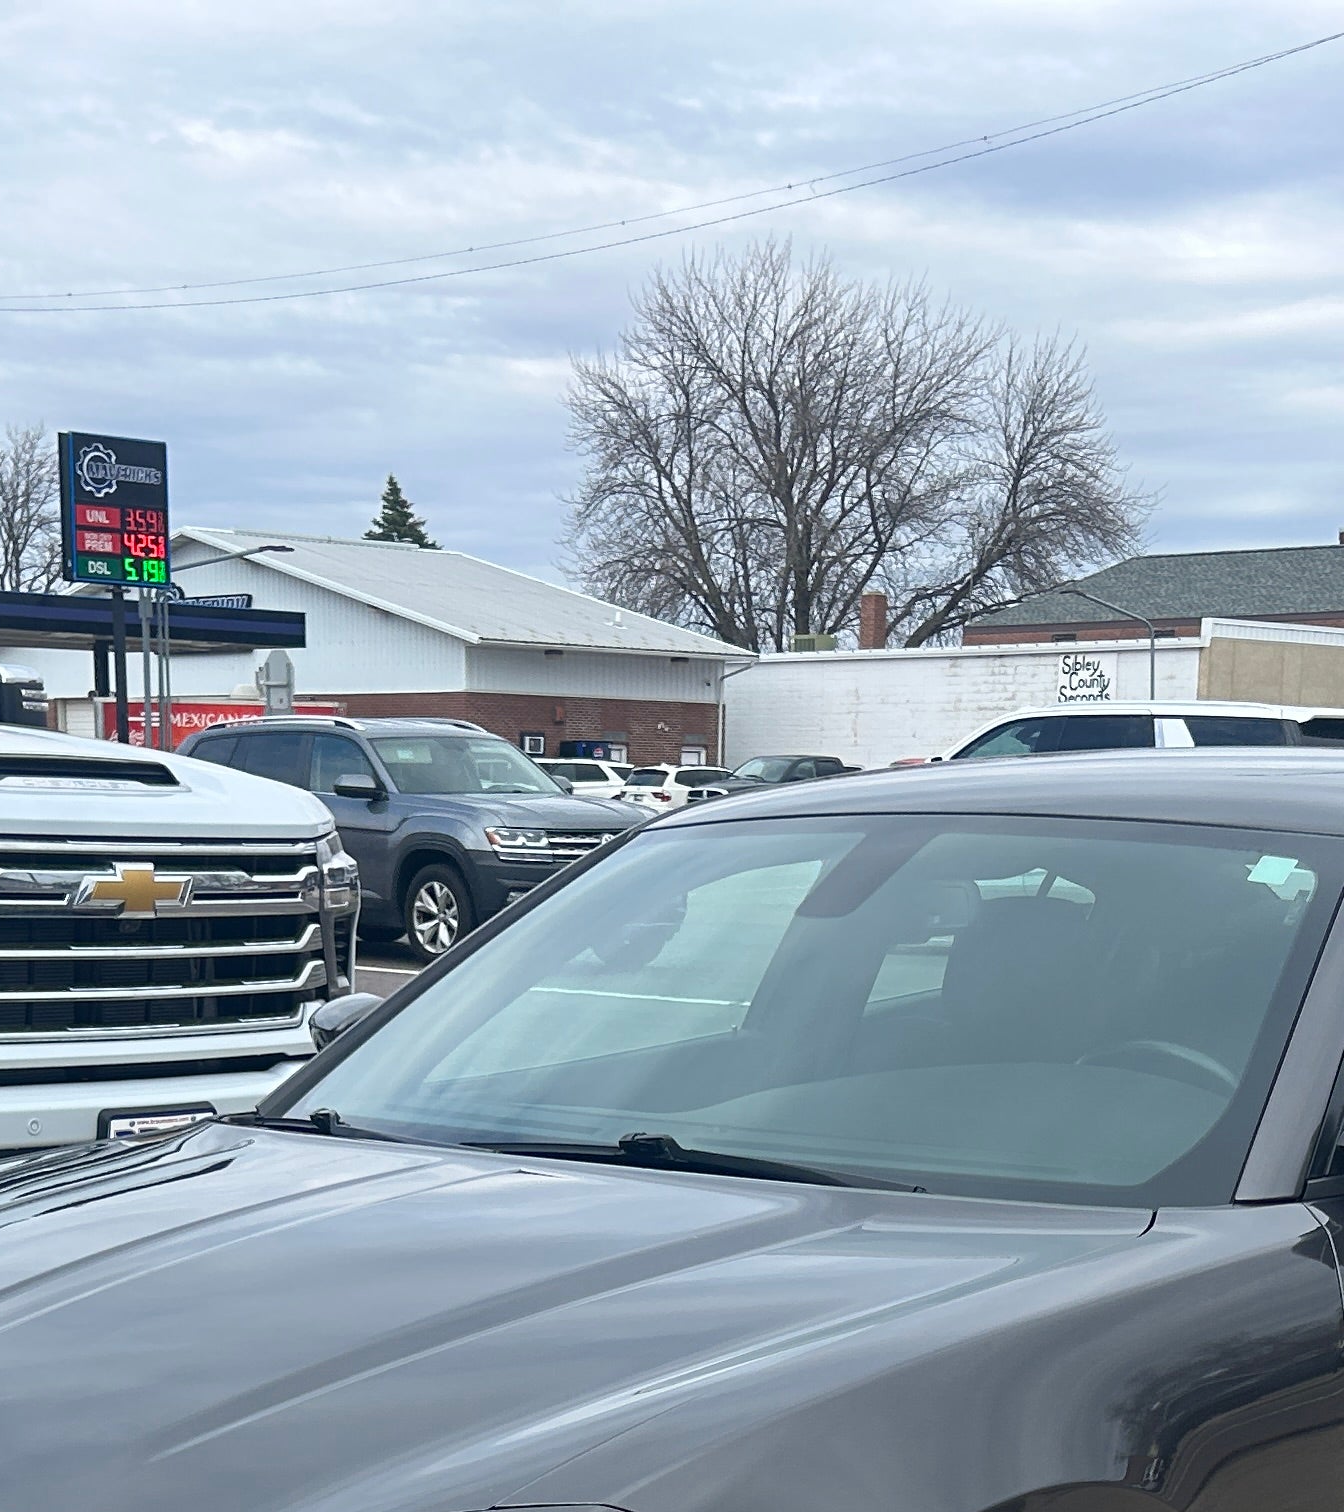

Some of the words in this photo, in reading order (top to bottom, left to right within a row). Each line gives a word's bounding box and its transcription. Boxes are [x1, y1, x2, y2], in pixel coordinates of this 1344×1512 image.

[85, 510, 110, 524] UNL
[88, 560, 112, 575] DSL
[1062, 655, 1101, 677] Sibley
[1069, 670, 1111, 693] County
